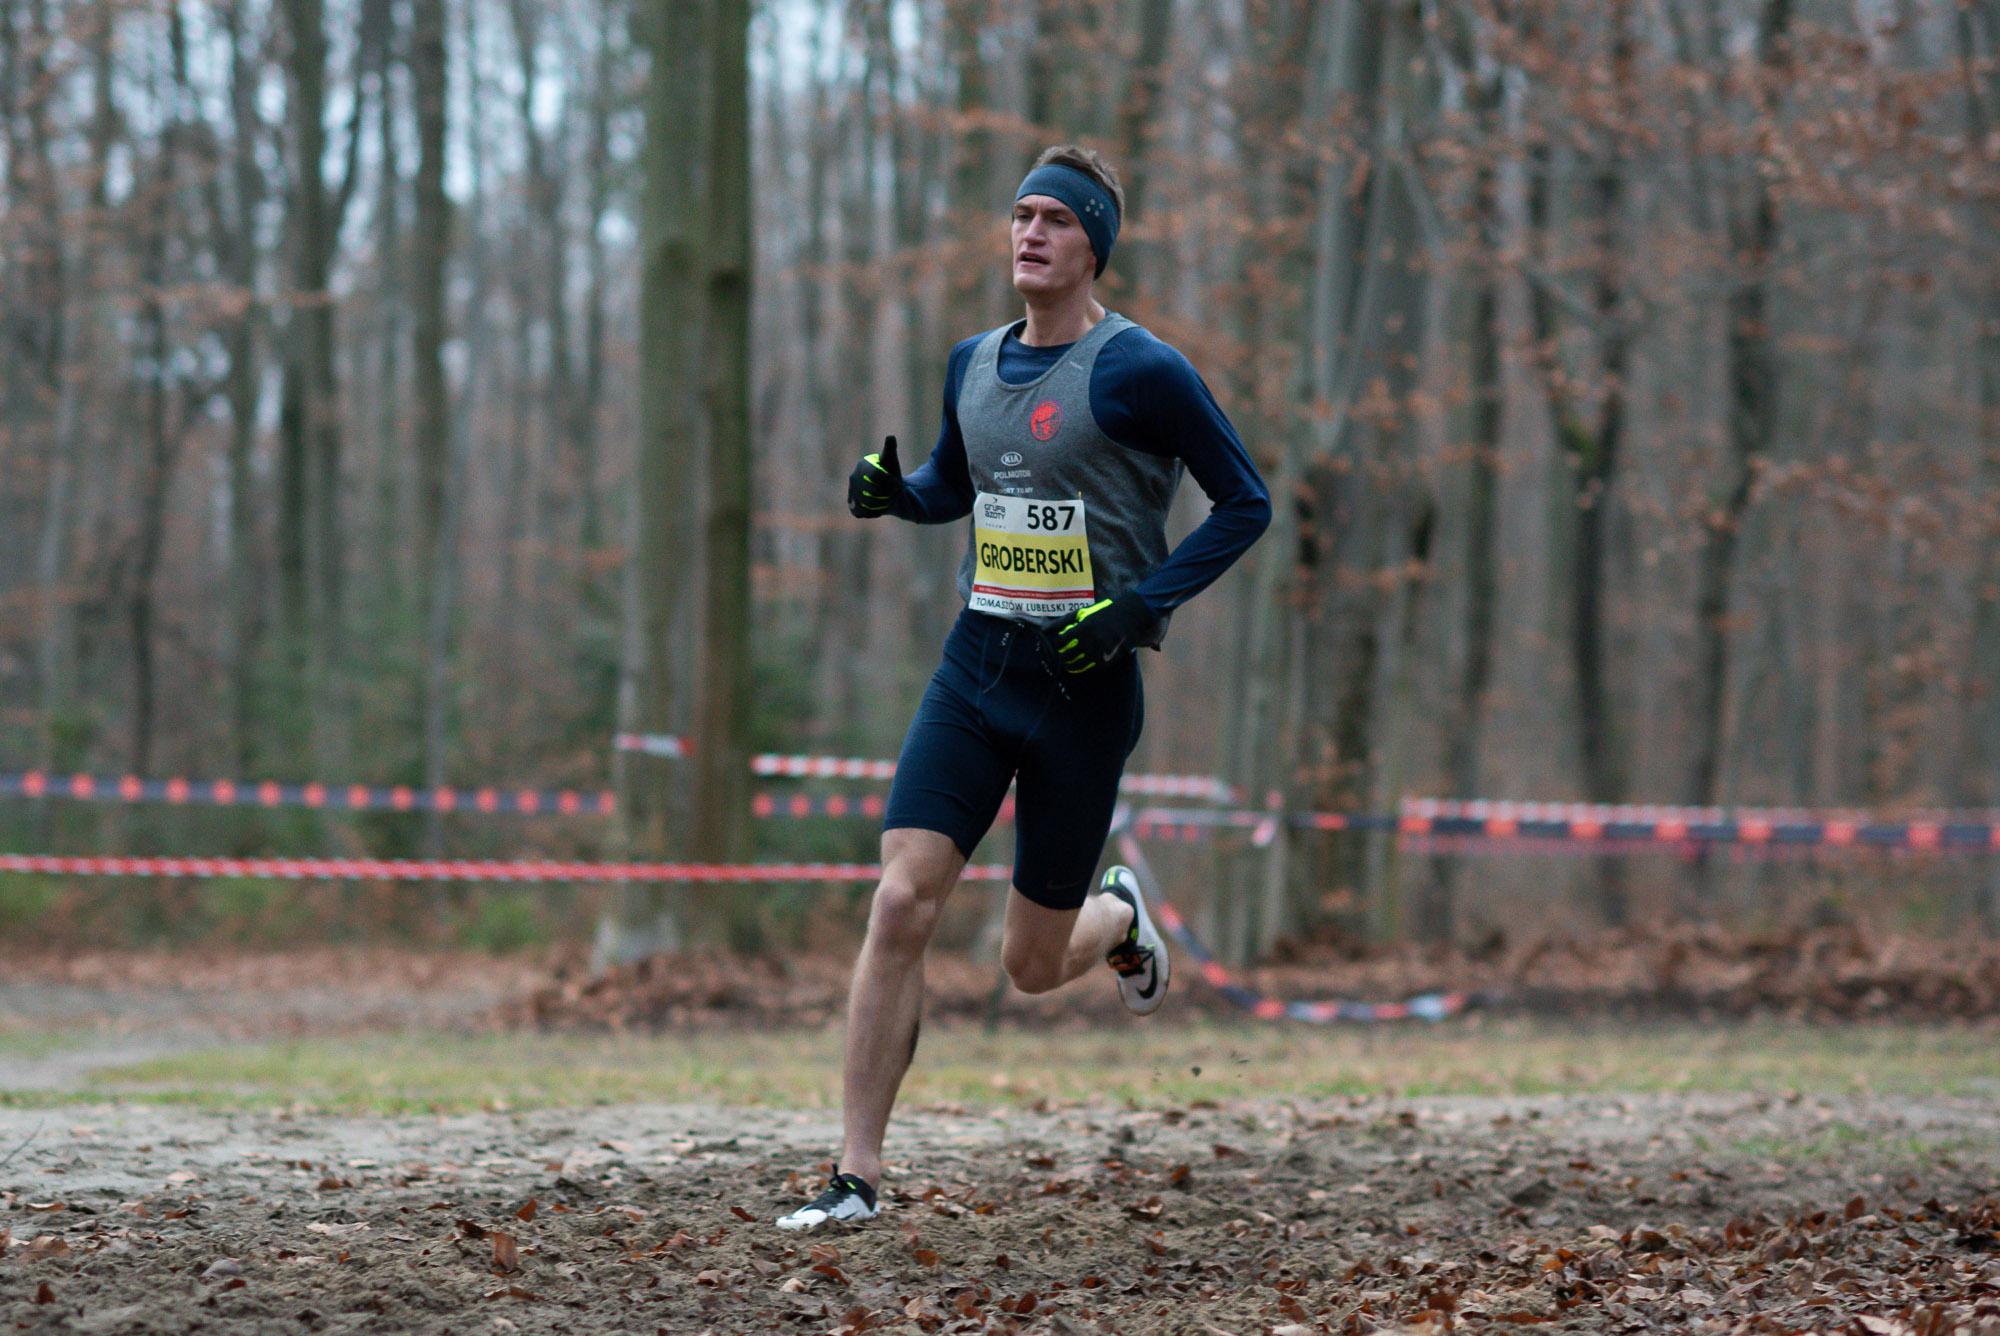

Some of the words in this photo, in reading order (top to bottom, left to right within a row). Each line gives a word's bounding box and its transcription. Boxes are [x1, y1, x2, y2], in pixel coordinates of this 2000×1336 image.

[1004, 455, 1019, 463] KIA
[994, 470, 1031, 480] POLMOTOR
[1027, 504, 1076, 531] 587
[981, 542, 1084, 575] GROBERSKI
[976, 597, 1024, 611] TOMASZÓW
[1026, 602, 1065, 612] LUBELSKI
